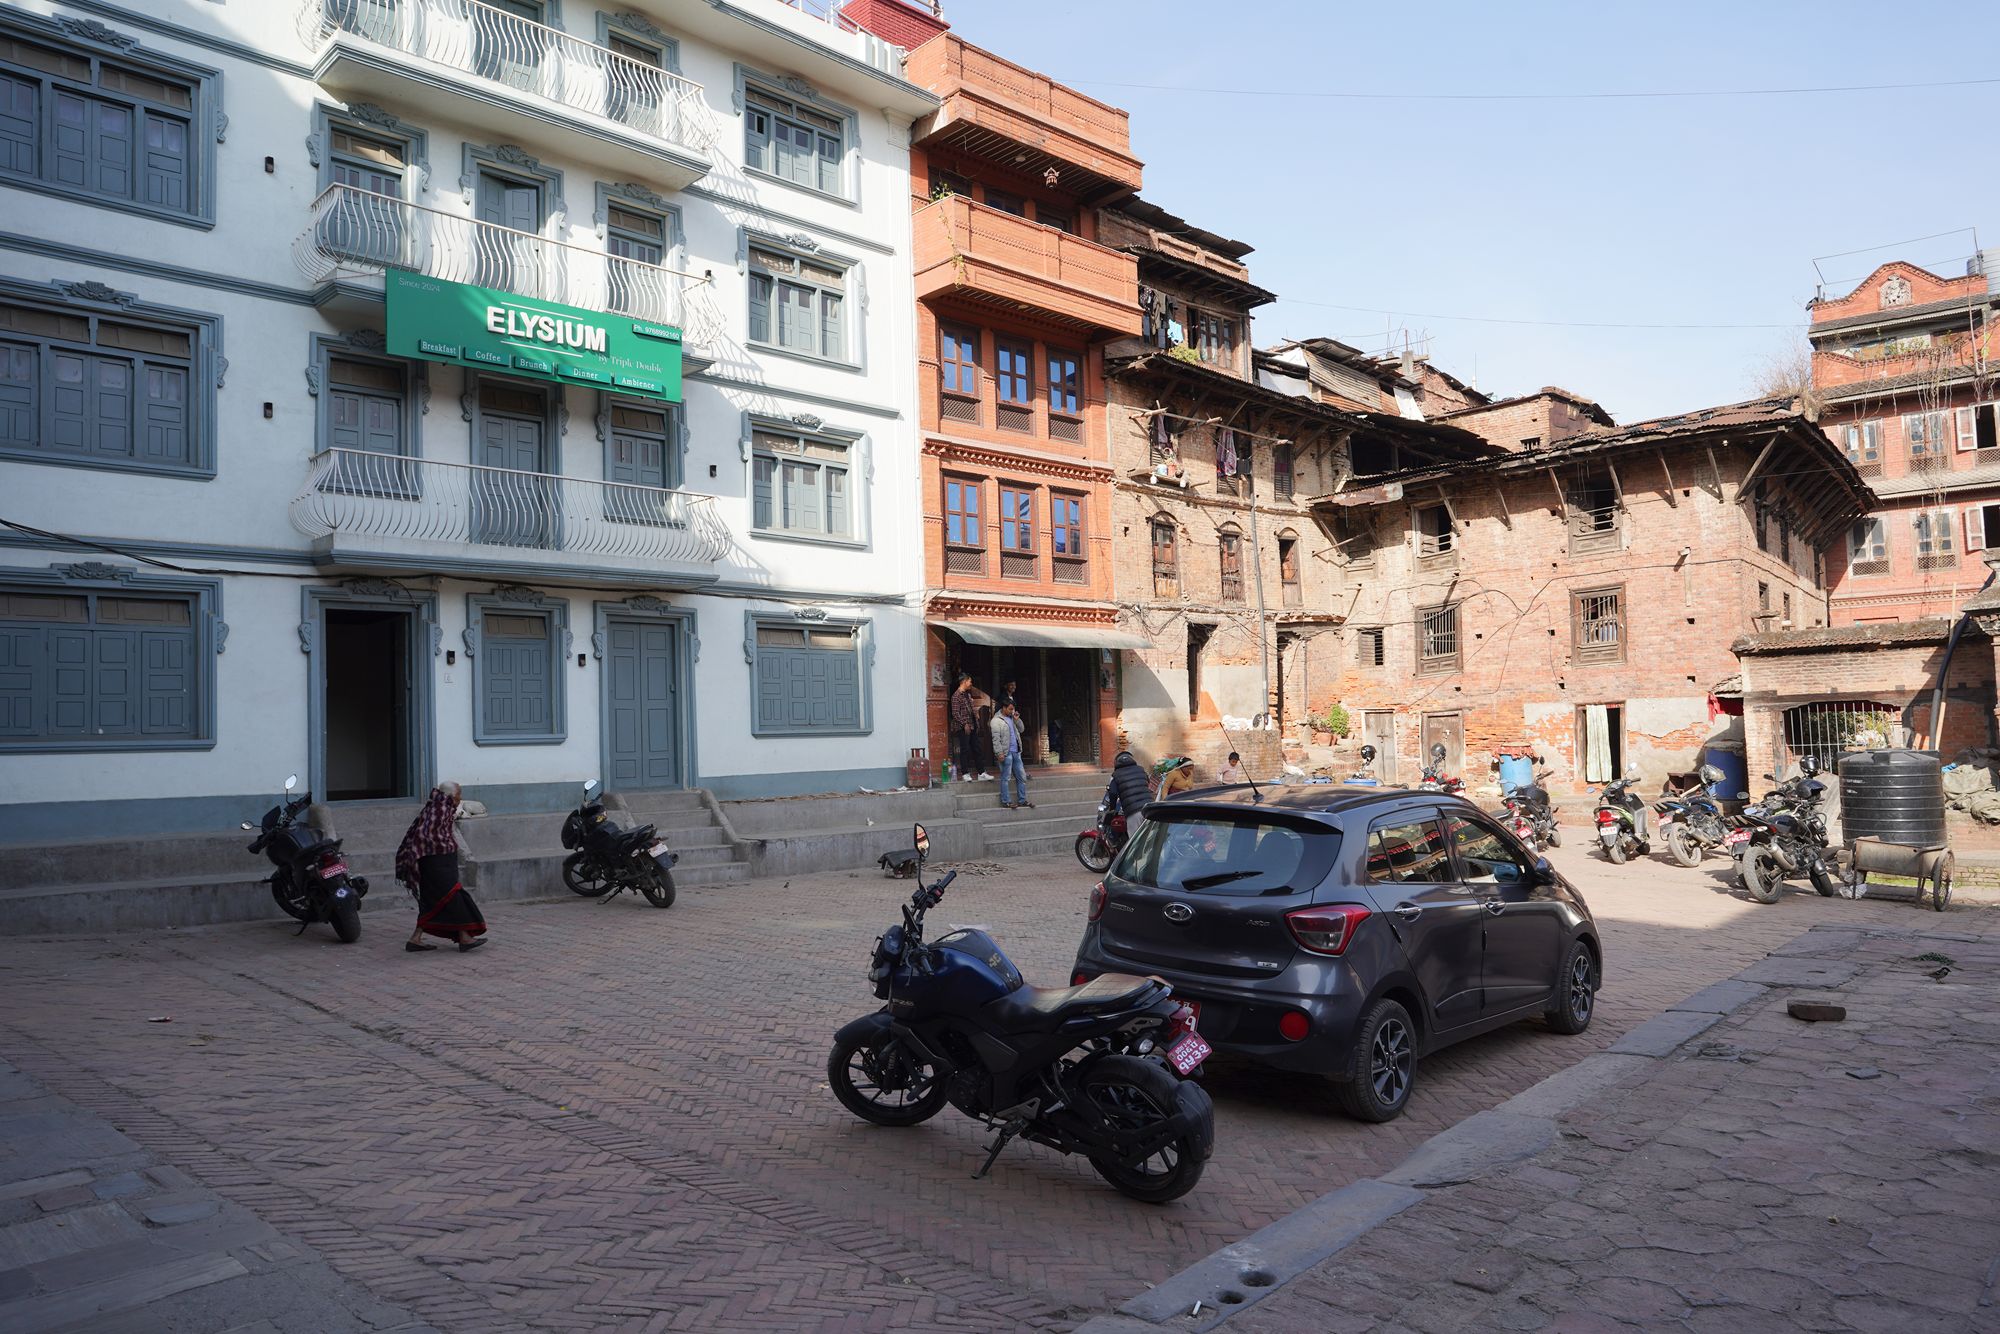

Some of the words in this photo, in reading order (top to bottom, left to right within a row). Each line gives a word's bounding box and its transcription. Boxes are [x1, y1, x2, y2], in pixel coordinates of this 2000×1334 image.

[399, 277, 420, 289] Since
[487, 306, 606, 352] ELYSIUM
[422, 341, 457, 355] Breakfast
[475, 351, 501, 362] Coffee
[520, 359, 548, 370] Brunch
[573, 368, 599, 380] Dinner
[621, 377, 655, 389] Ambience
[611, 356, 633, 368] Triple
[636, 360, 663, 373] Double
